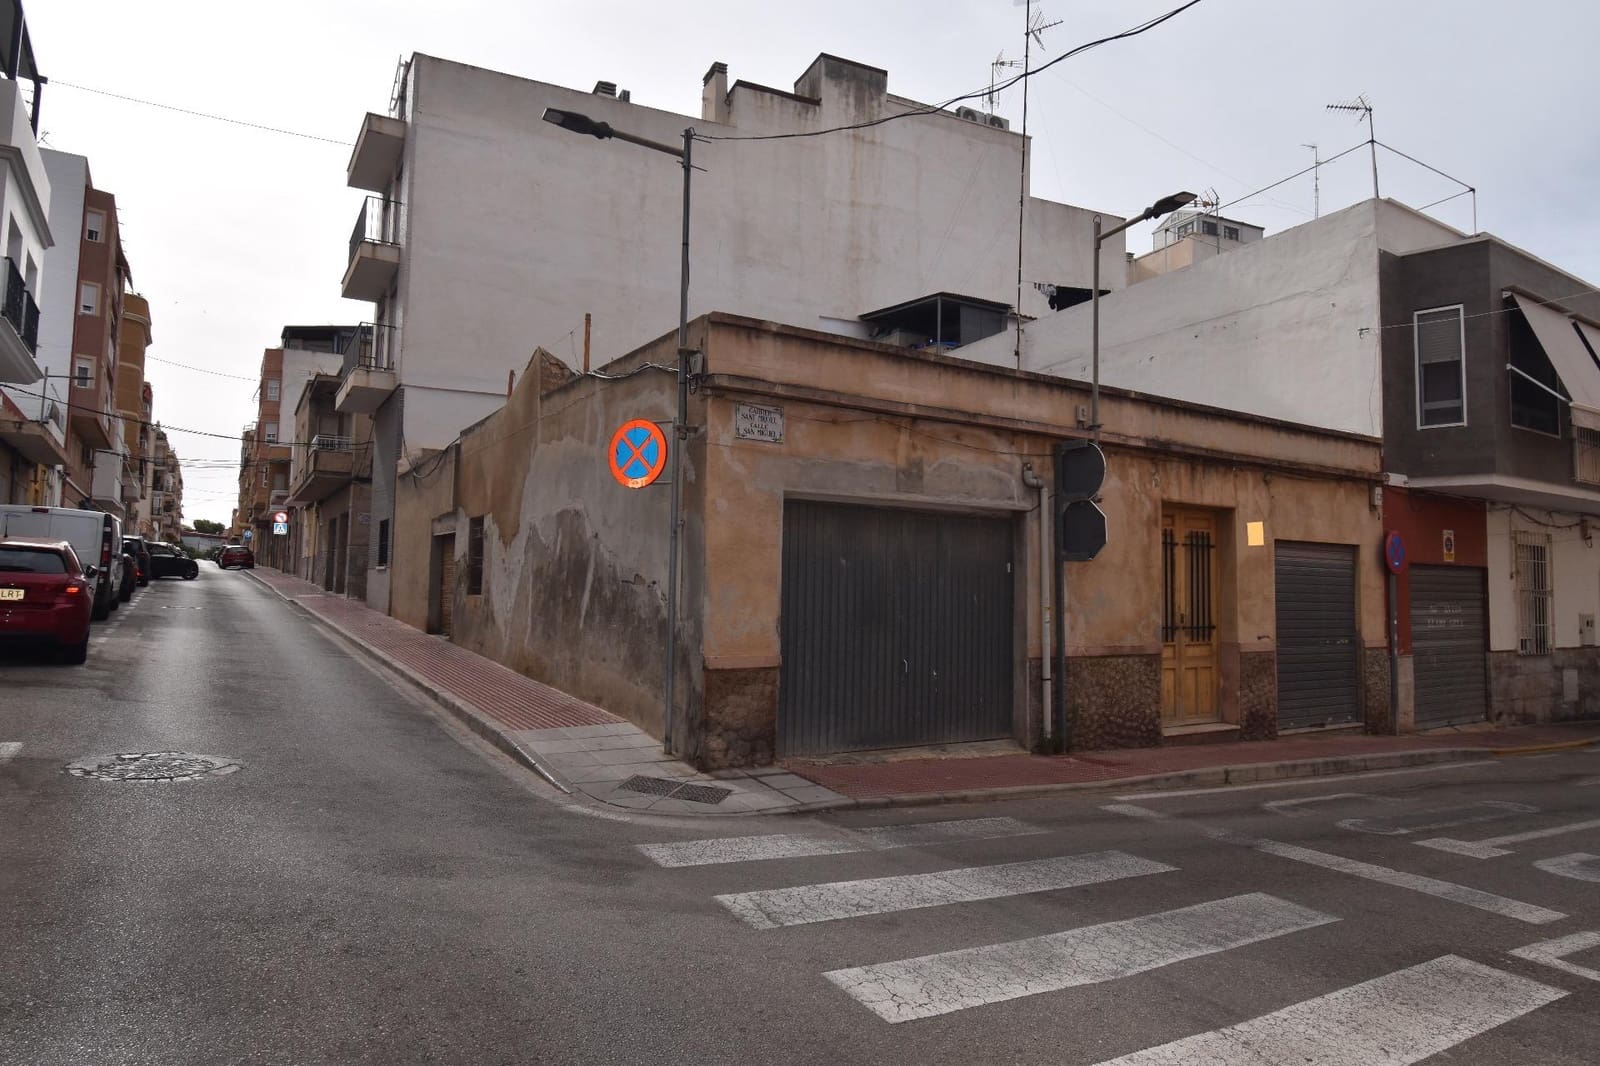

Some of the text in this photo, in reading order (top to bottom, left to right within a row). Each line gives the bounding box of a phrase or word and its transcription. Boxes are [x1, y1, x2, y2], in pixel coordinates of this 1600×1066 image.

[741, 413, 755, 421] SANT
[757, 429, 776, 437] MIGUEL
[1, 590, 20, 598] LRT
